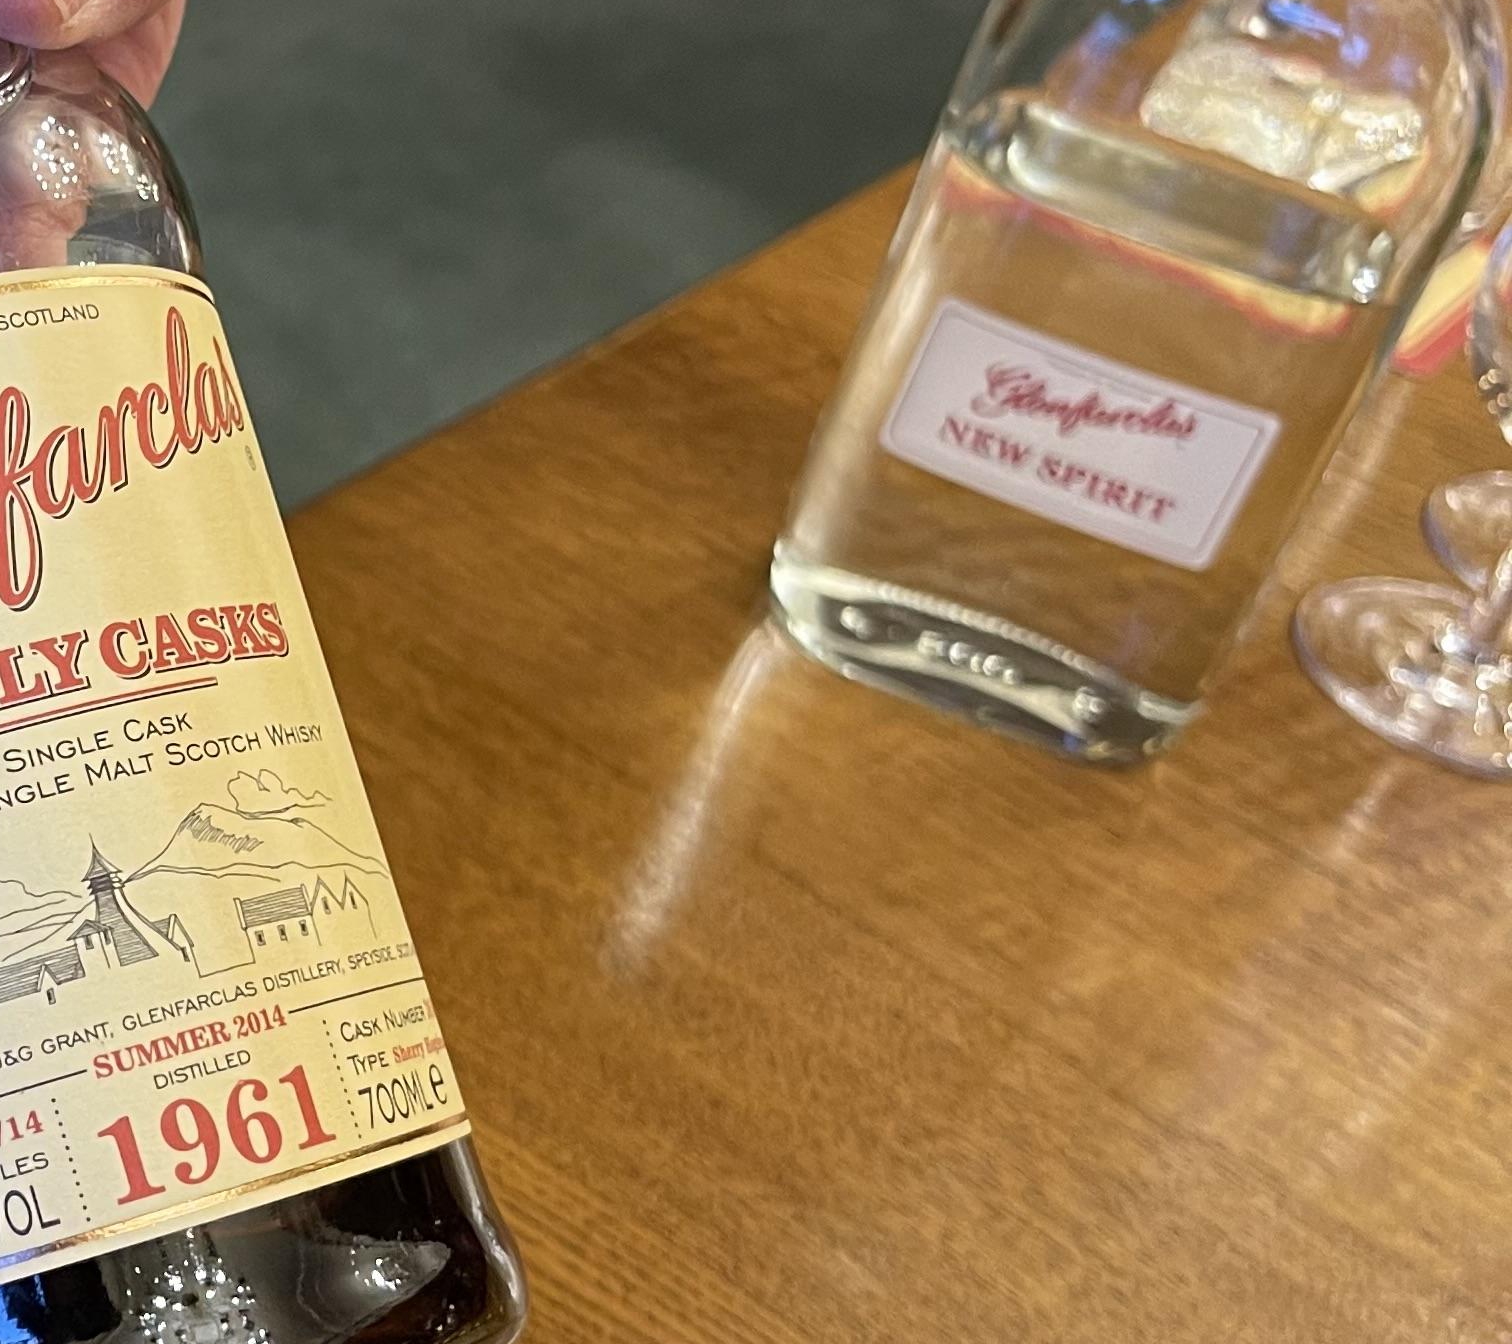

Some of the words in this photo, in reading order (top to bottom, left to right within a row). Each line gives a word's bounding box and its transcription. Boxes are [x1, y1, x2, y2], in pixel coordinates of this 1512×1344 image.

[940, 416, 1030, 467] NEW
[1037, 455, 1177, 522] SPIRIT
[98, 602, 290, 680] CASKS
[2, 729, 114, 773] SINGLE
[123, 712, 194, 743] CASK
[84, 753, 155, 786] MALT
[164, 730, 263, 766] SCOTCH
[265, 723, 325, 747] WHISKY
[40, 1021, 115, 1055] GRANT,
[121, 981, 258, 1032] GLENFARCLAS
[262, 957, 346, 993] DISTILLERY,
[340, 1018, 383, 1042] CASK
[92, 1020, 232, 1080] SUMMER
[232, 1004, 288, 1039] 2014
[153, 1049, 252, 1090] DISTILLED
[346, 1050, 390, 1076] TYPE
[358, 1069, 434, 1129] 700ML
[97, 1064, 337, 1205] 1961
